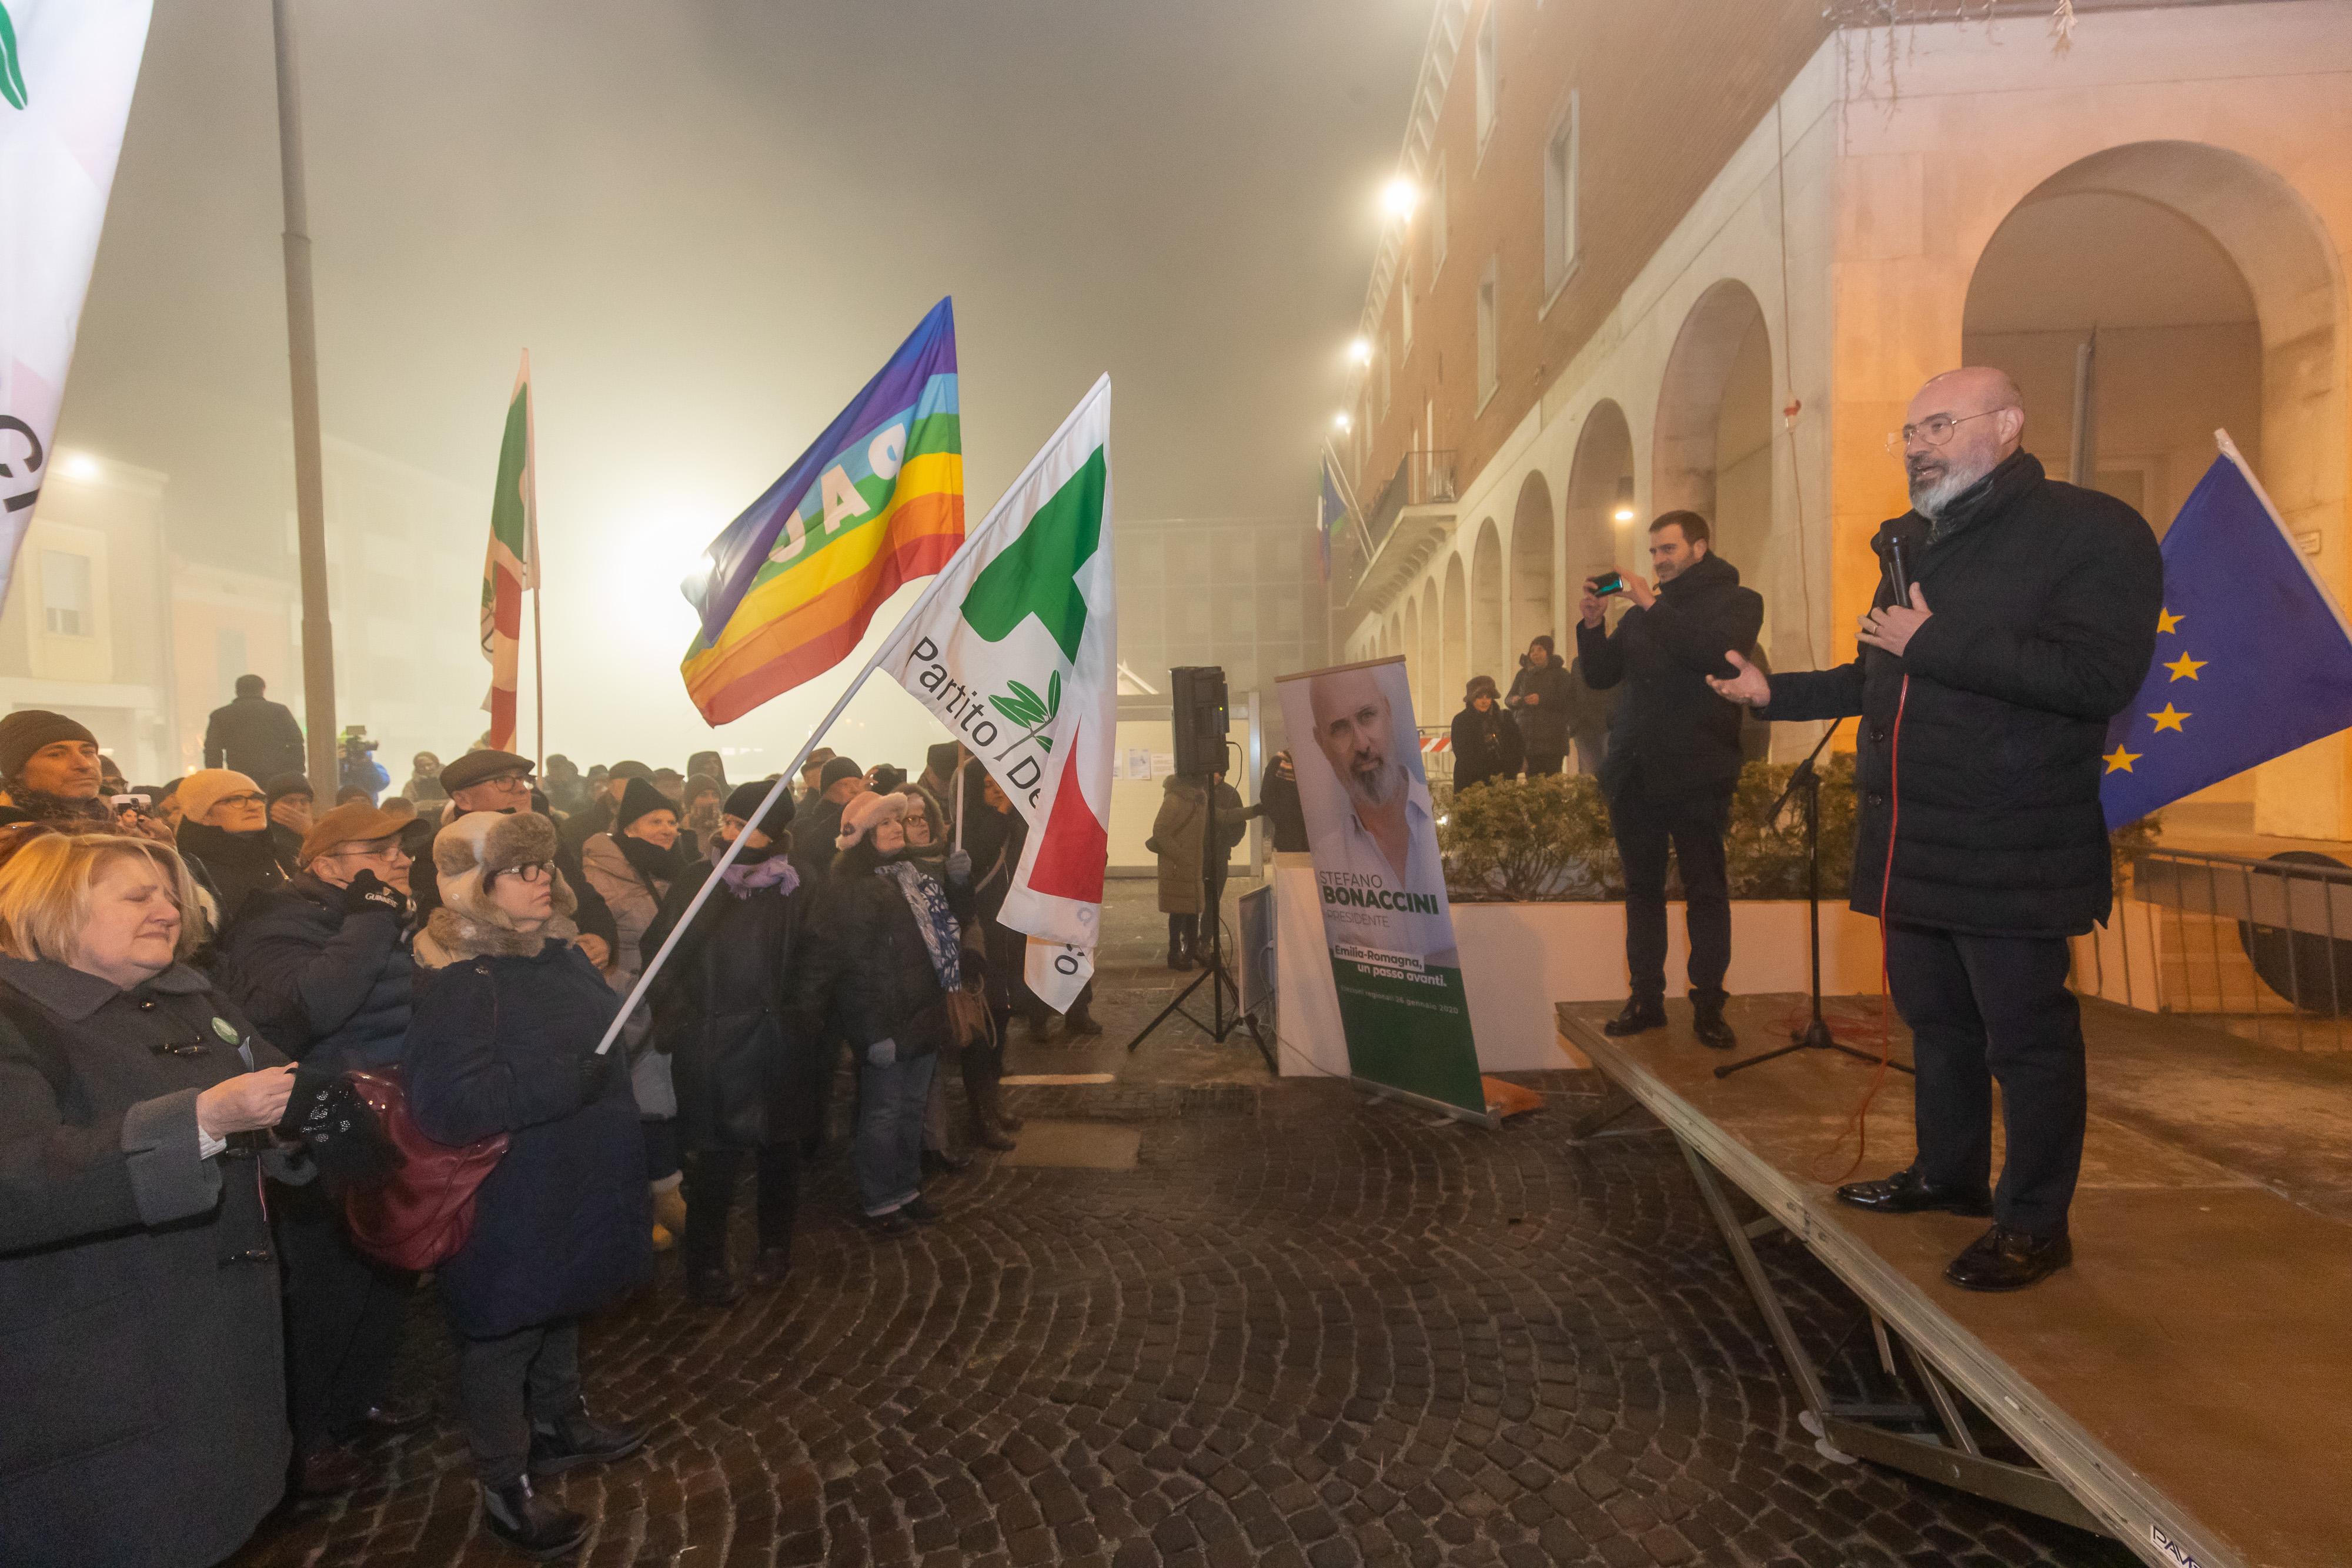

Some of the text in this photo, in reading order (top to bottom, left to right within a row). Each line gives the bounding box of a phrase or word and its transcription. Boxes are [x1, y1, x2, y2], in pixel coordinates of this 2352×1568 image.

[906, 636, 998, 747] Partito
[1319, 871, 1382, 888] STEFANO
[1323, 885, 1439, 915] BONACCINI
[1327, 909, 1391, 928] PRESIDENTE
[1335, 945, 1423, 969] Emilia-Romagna,
[1358, 964, 1447, 987] un passo avanti.
[1396, 995, 1405, 1004] 26
[1406, 998, 1436, 1009] gennaio
[1439, 1004, 1459, 1014] 2020
